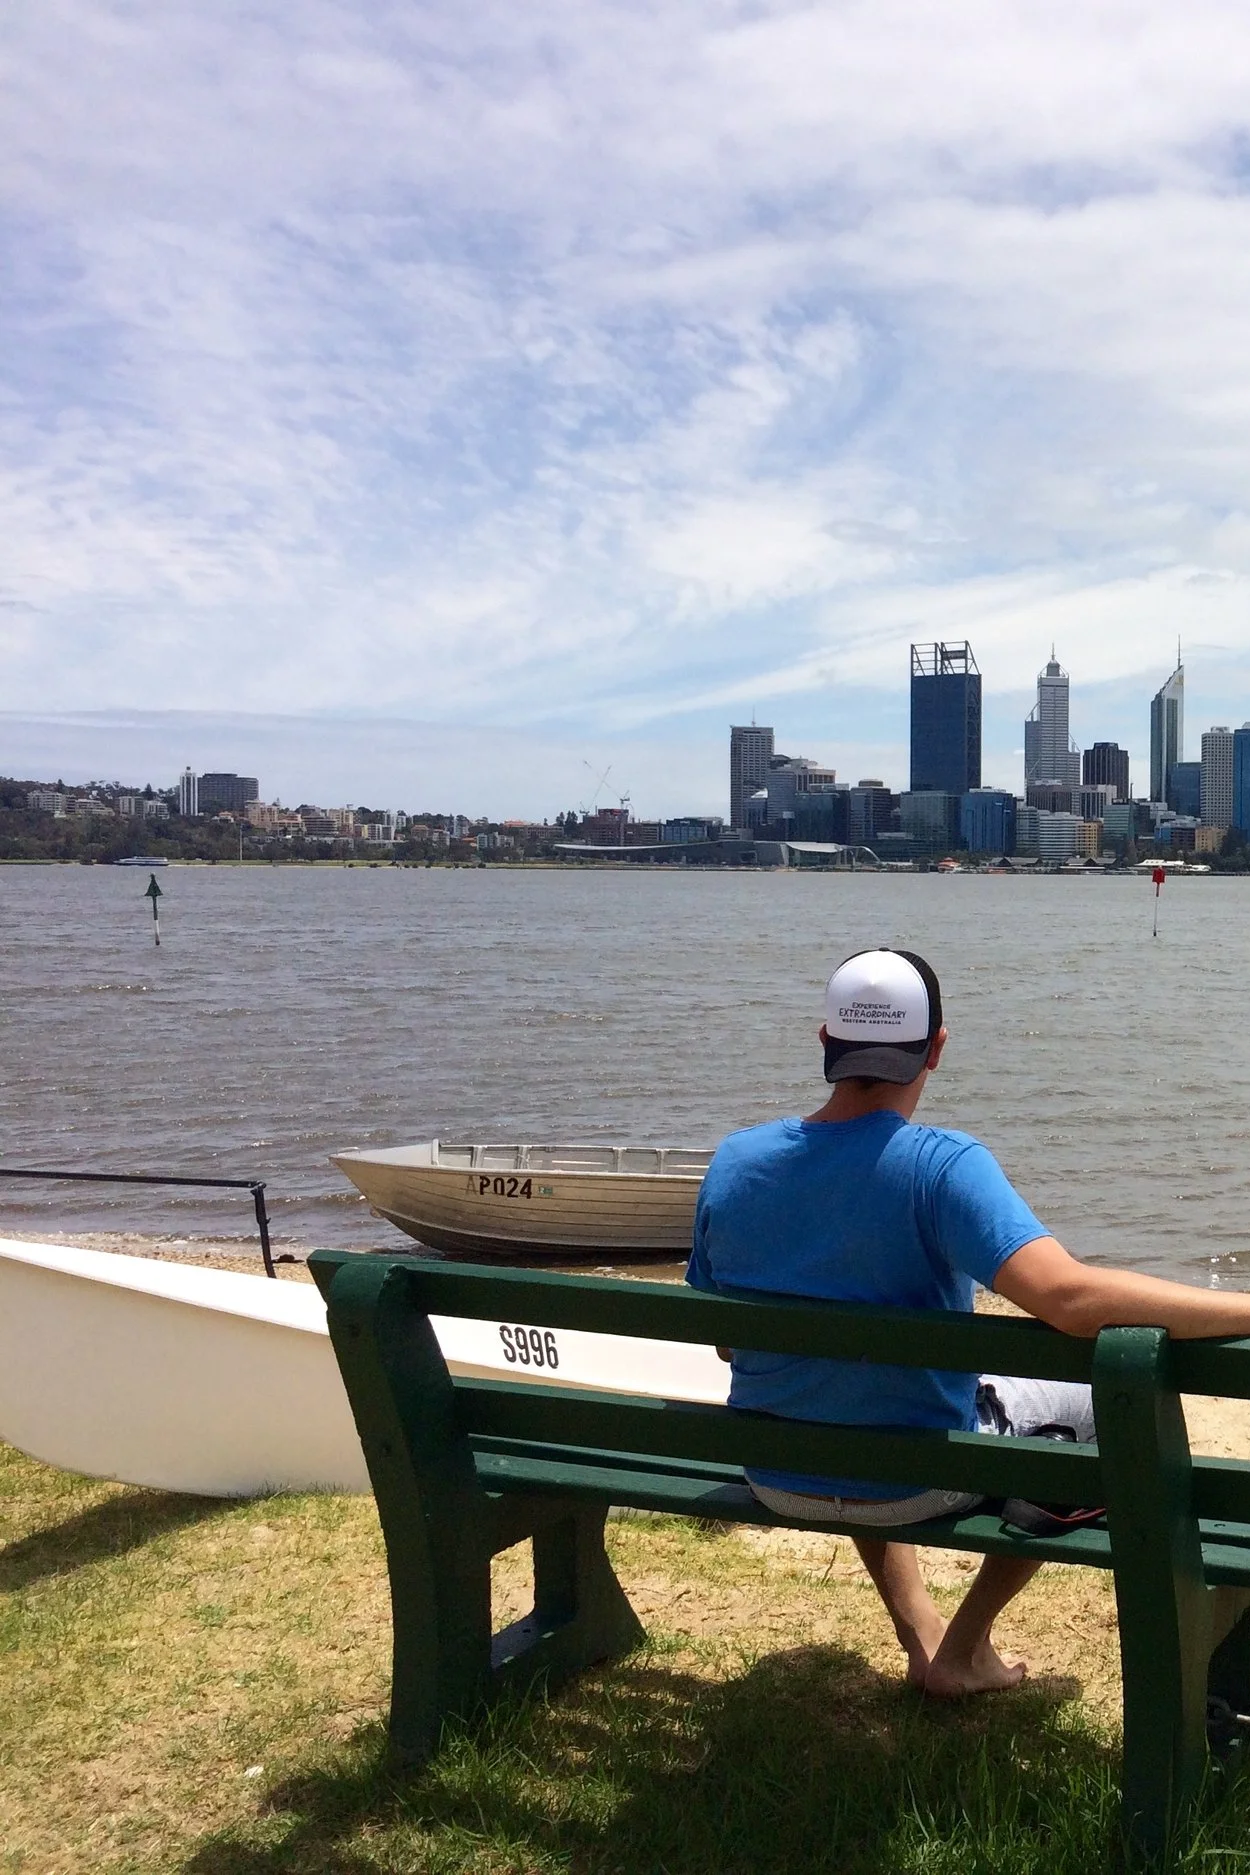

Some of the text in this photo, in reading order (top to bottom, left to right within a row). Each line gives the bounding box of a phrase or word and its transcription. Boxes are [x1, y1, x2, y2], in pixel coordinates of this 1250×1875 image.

[852, 1001, 891, 1010] EXPERIENCE
[839, 1008, 907, 1018] EXTRAORDINARY
[499, 1325, 559, 1369] S996
